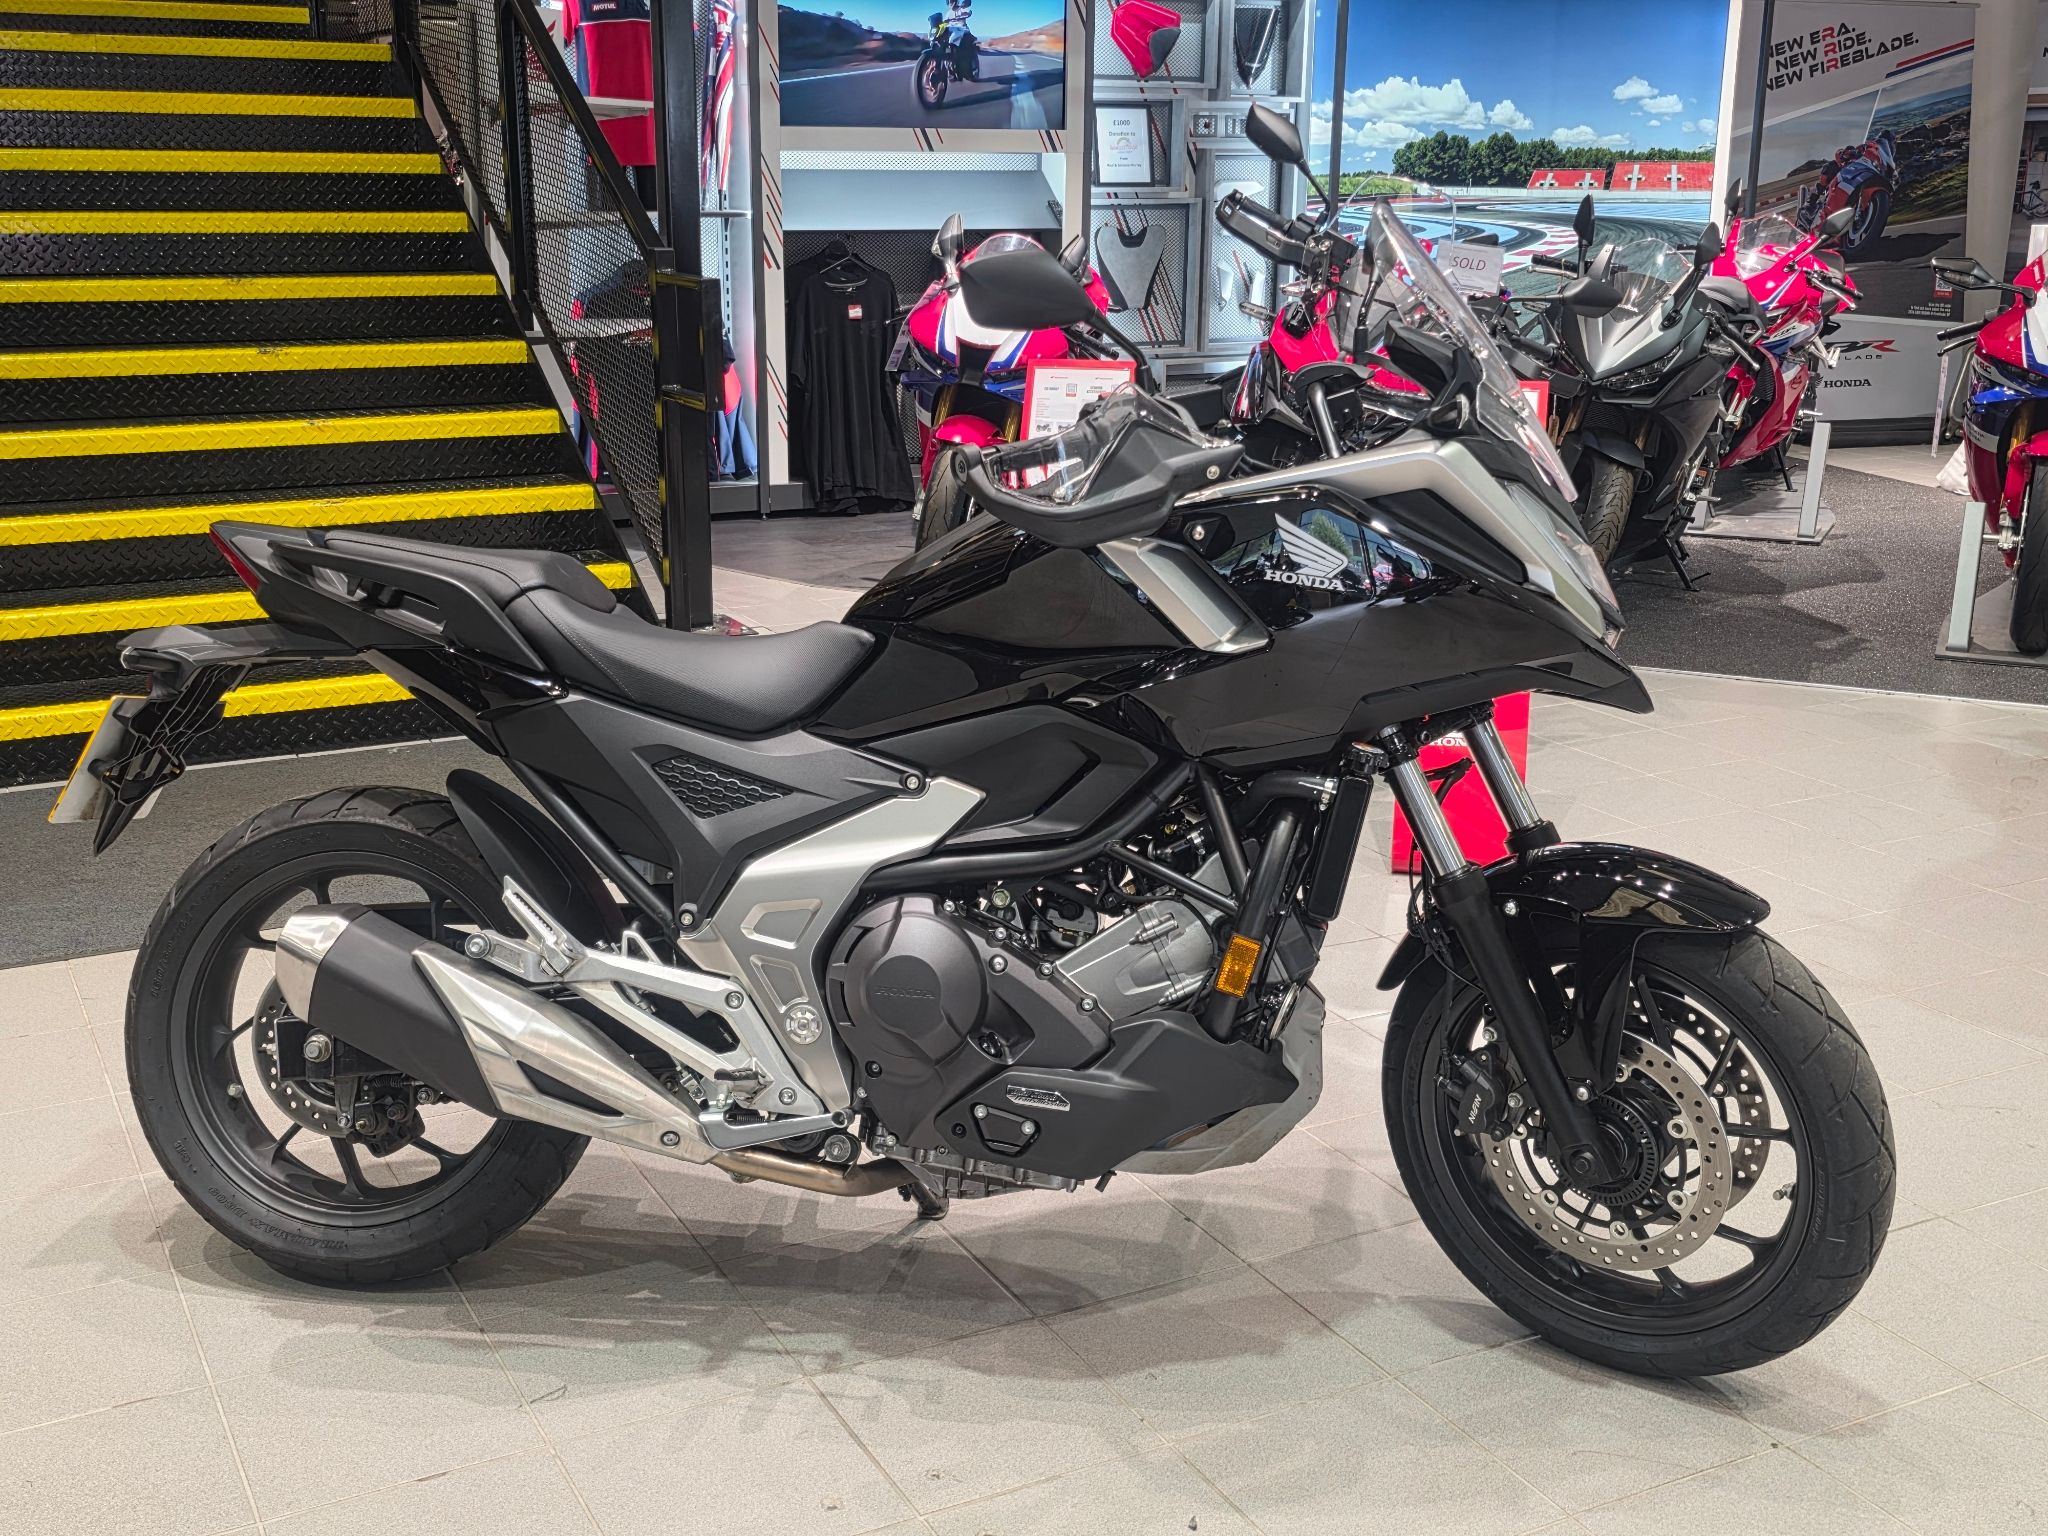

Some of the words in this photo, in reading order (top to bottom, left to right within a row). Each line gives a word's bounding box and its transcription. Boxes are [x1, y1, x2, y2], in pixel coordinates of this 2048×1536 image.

[593, 3, 616, 12] MOTUL
[1809, 22, 1856, 46] ERA.
[1775, 48, 1818, 72] NEW
[1823, 31, 1872, 57] RIDE.
[1809, 32, 1920, 78] FIREBLADE.
[1451, 256, 1487, 271] SOLD
[1823, 378, 1872, 389] HONDA
[1263, 568, 1346, 592] HONDA
[1468, 1093, 1482, 1124] NISSIN
